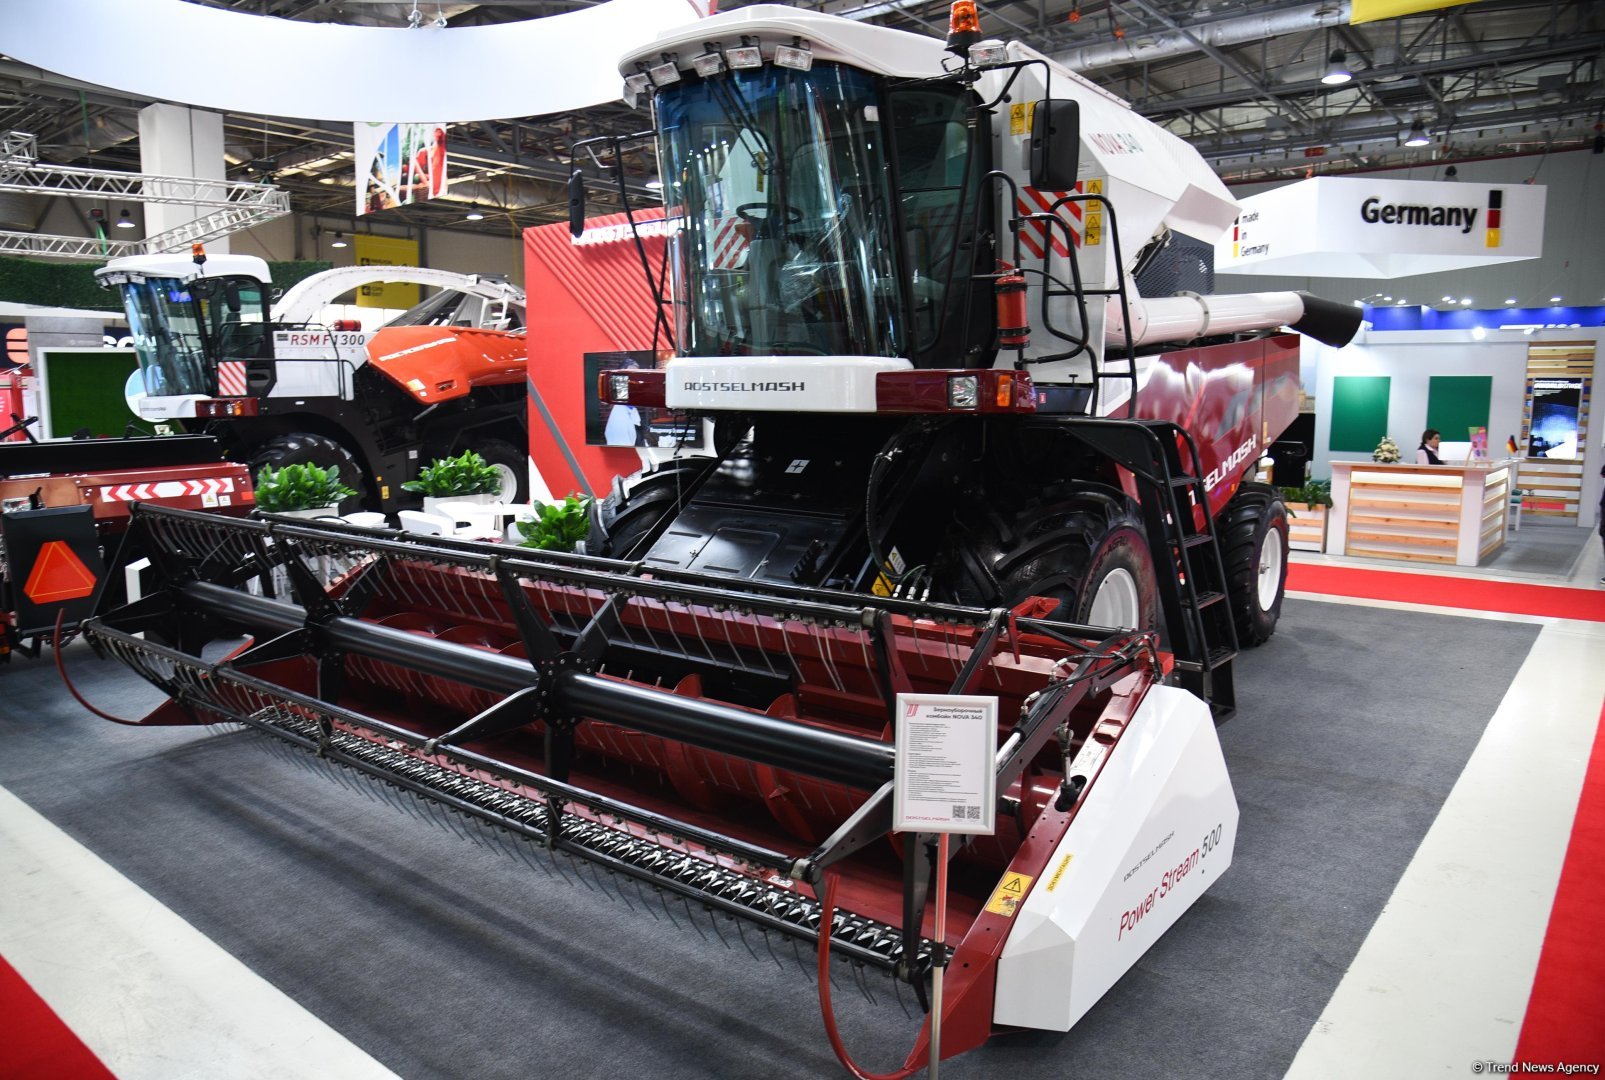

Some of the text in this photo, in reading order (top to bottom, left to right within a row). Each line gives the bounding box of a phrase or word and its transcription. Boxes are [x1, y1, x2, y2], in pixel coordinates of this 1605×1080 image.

[1242, 211, 1259, 223] made
[1361, 197, 1477, 234] Germany
[1241, 243, 1269, 257] Germany
[684, 382, 805, 392] ROSTSELMASH
[1123, 830, 1175, 882] ROSTSELMASH
[1118, 823, 1222, 942] Power Stream 500
